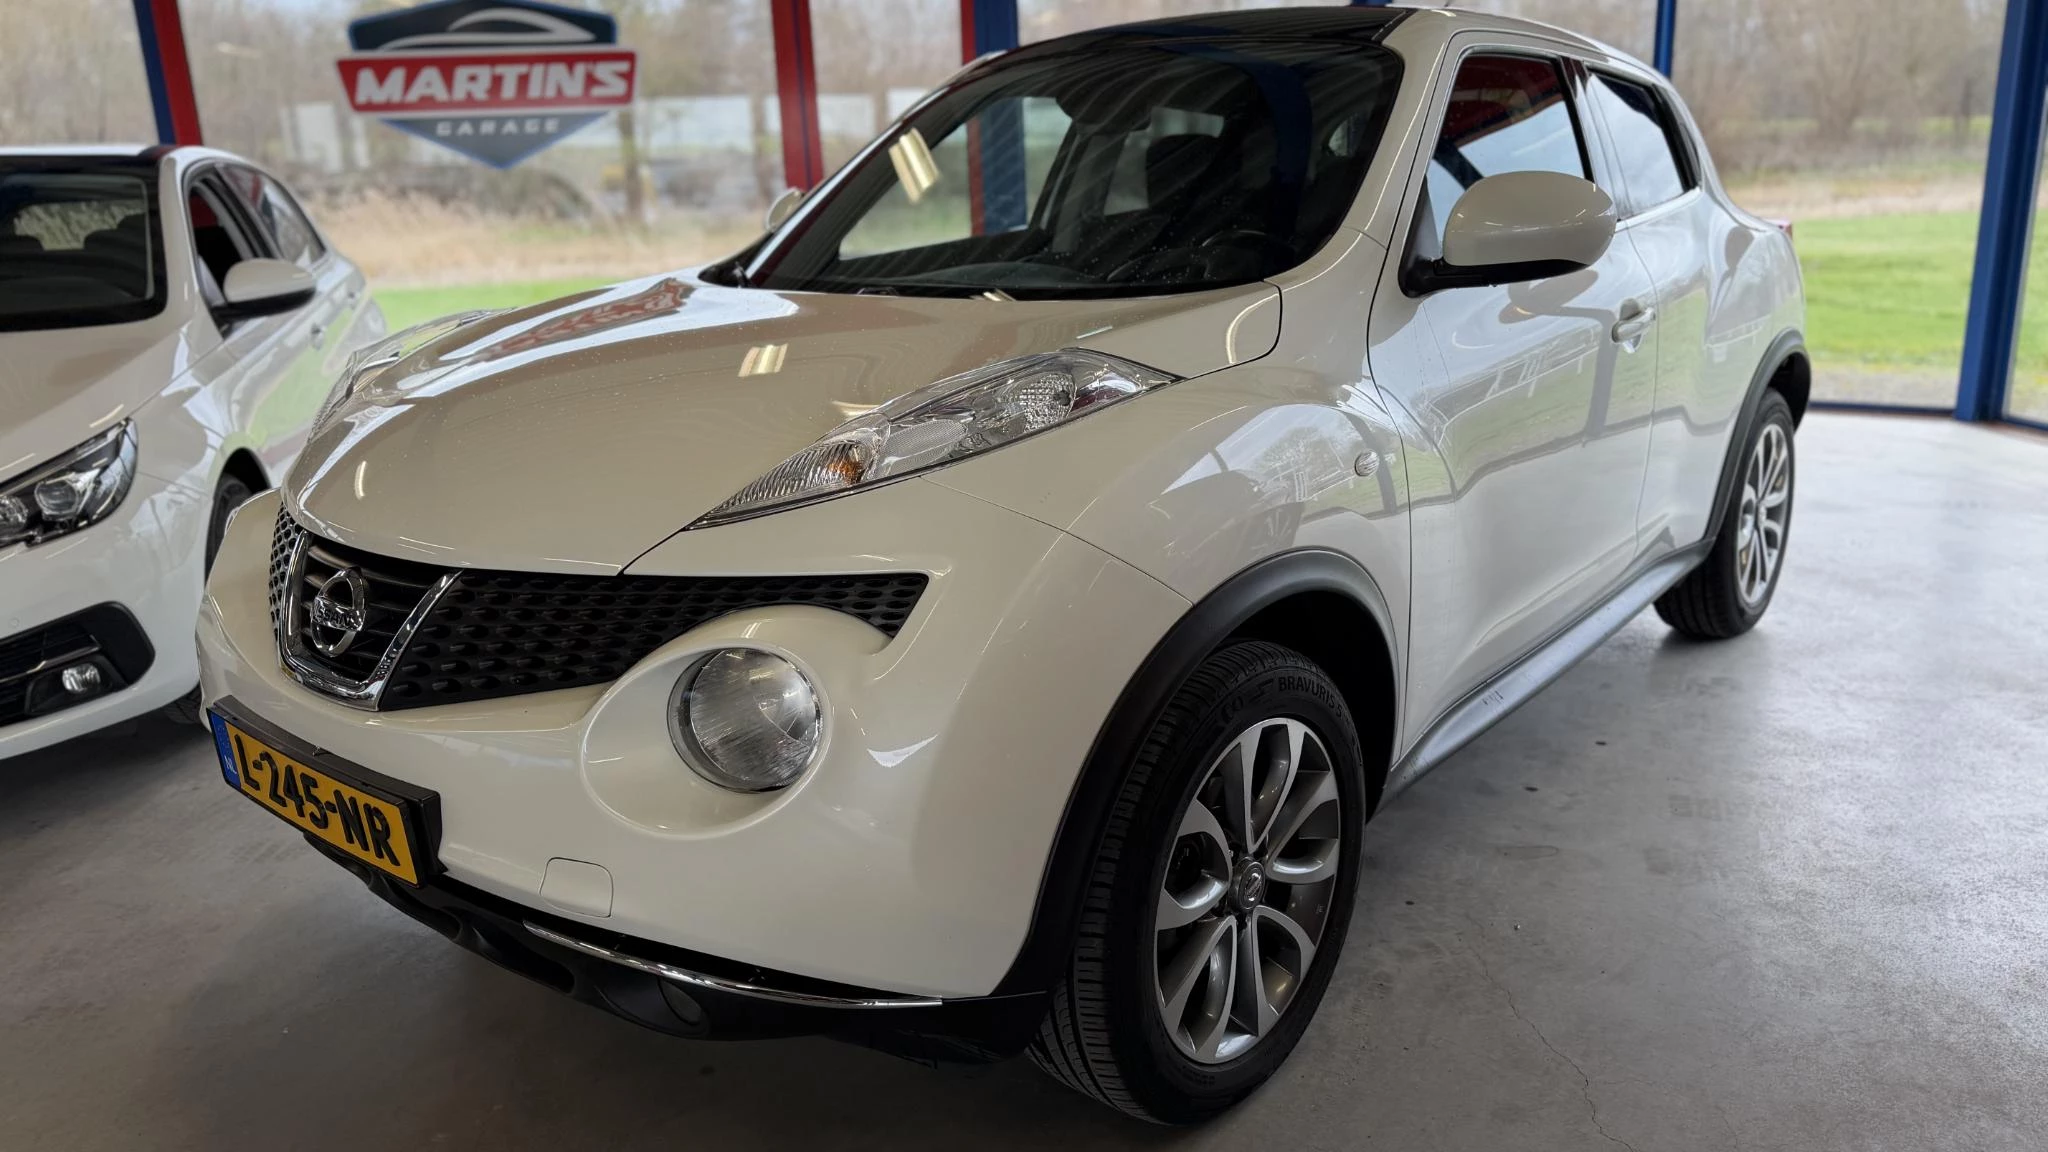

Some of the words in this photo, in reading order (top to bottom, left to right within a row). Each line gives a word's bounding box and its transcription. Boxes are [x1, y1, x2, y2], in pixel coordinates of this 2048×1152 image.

[355, 60, 631, 105] MARTIN'S
[436, 117, 561, 137] GARAGE
[1278, 675, 1335, 710] BRAVURIS
[223, 754, 238, 775] NL
[234, 733, 401, 867] L-245-NR
